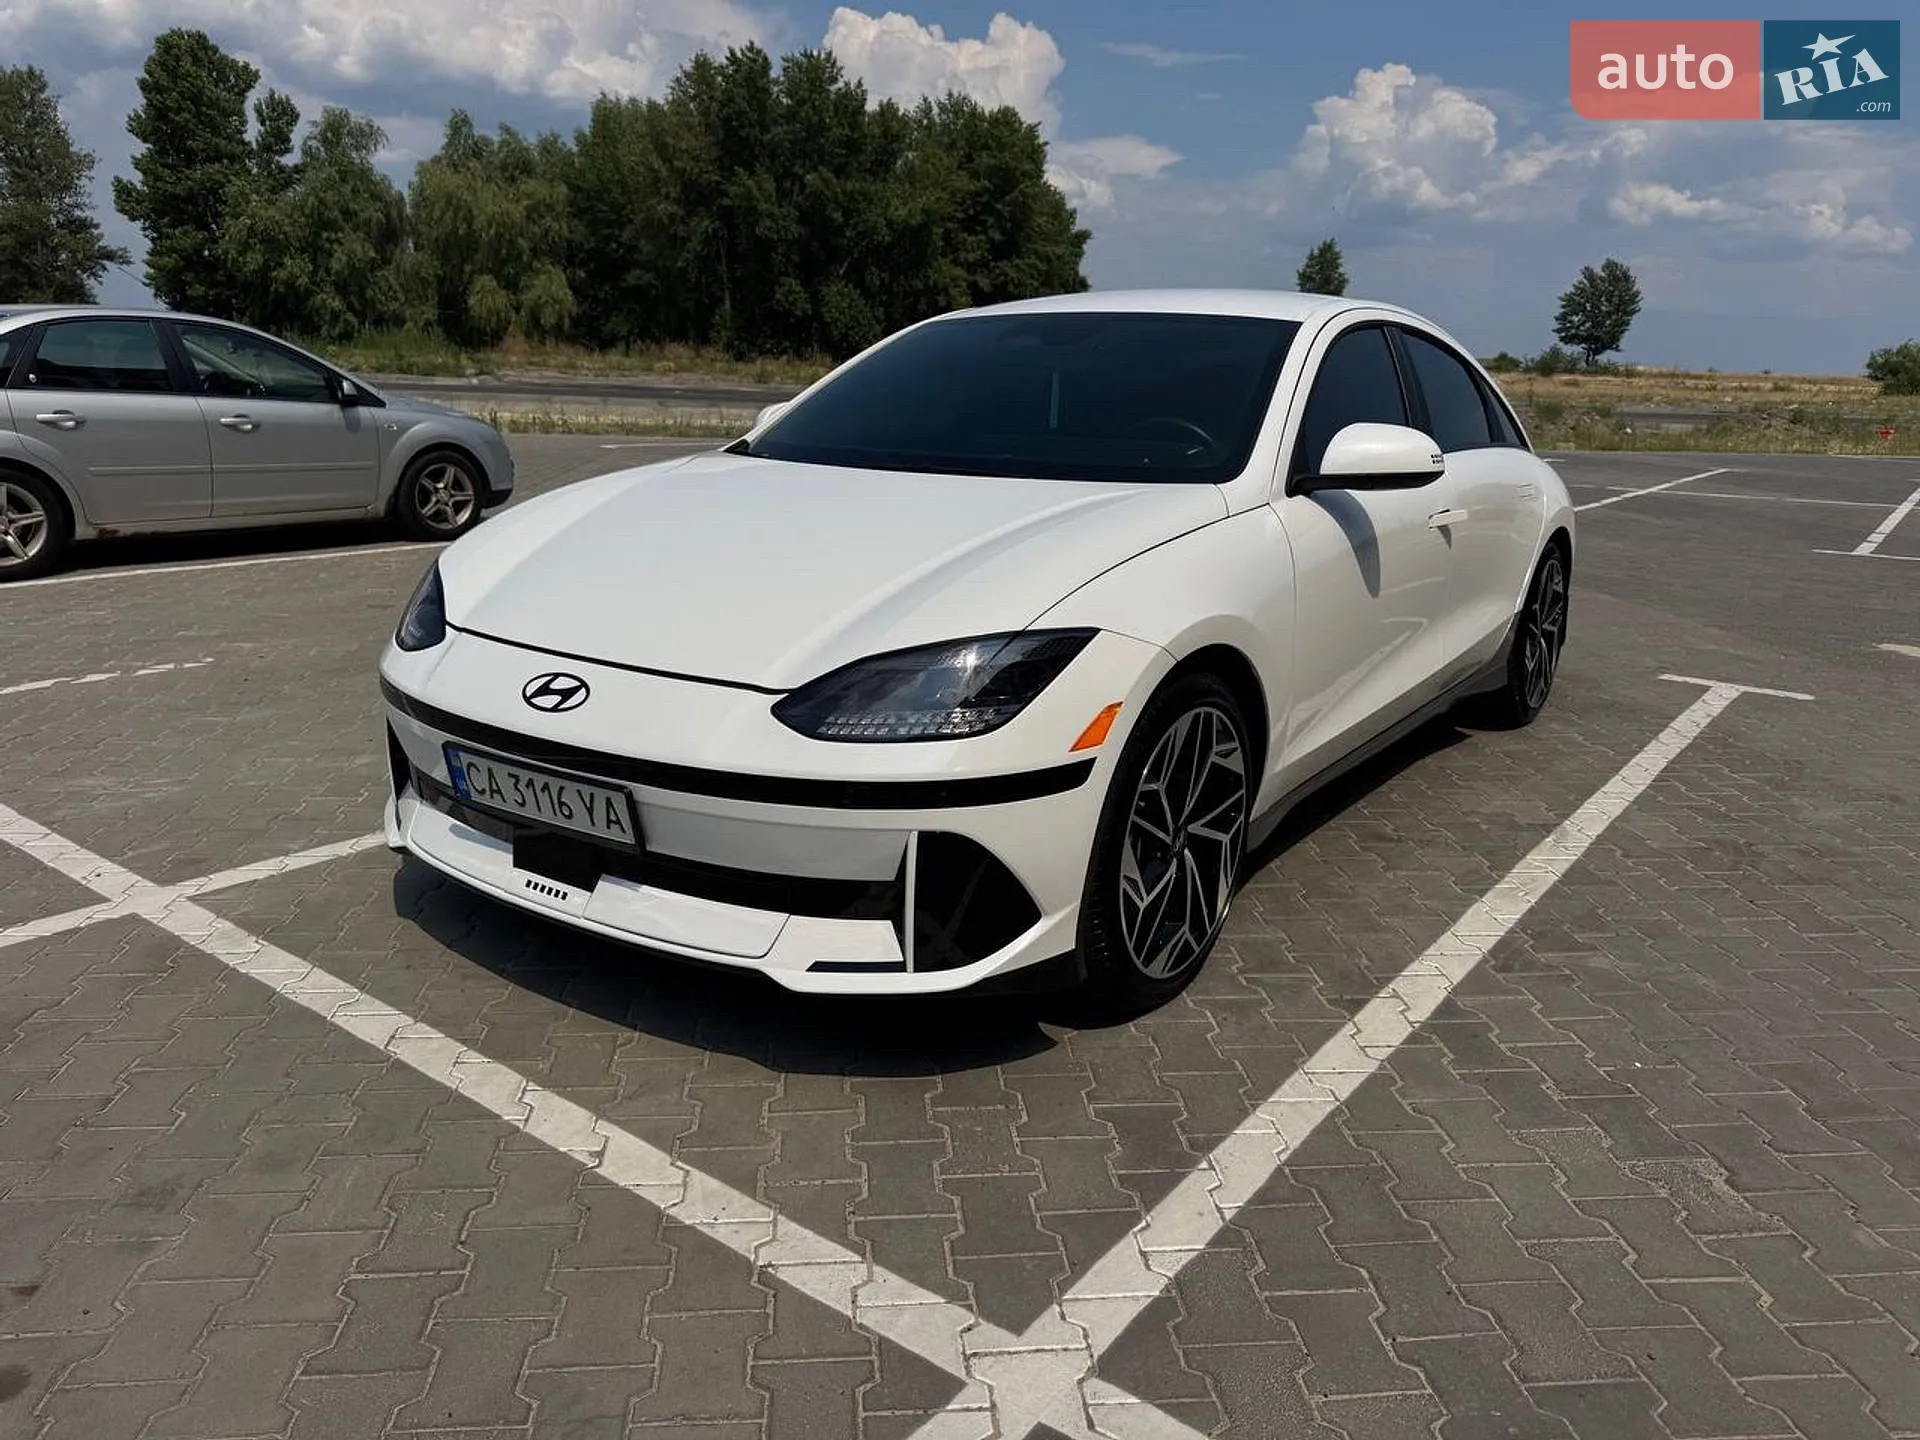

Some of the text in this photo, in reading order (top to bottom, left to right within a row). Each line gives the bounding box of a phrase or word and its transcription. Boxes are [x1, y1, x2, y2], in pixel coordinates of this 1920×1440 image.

[466, 762, 626, 835] CA 3116 YA
